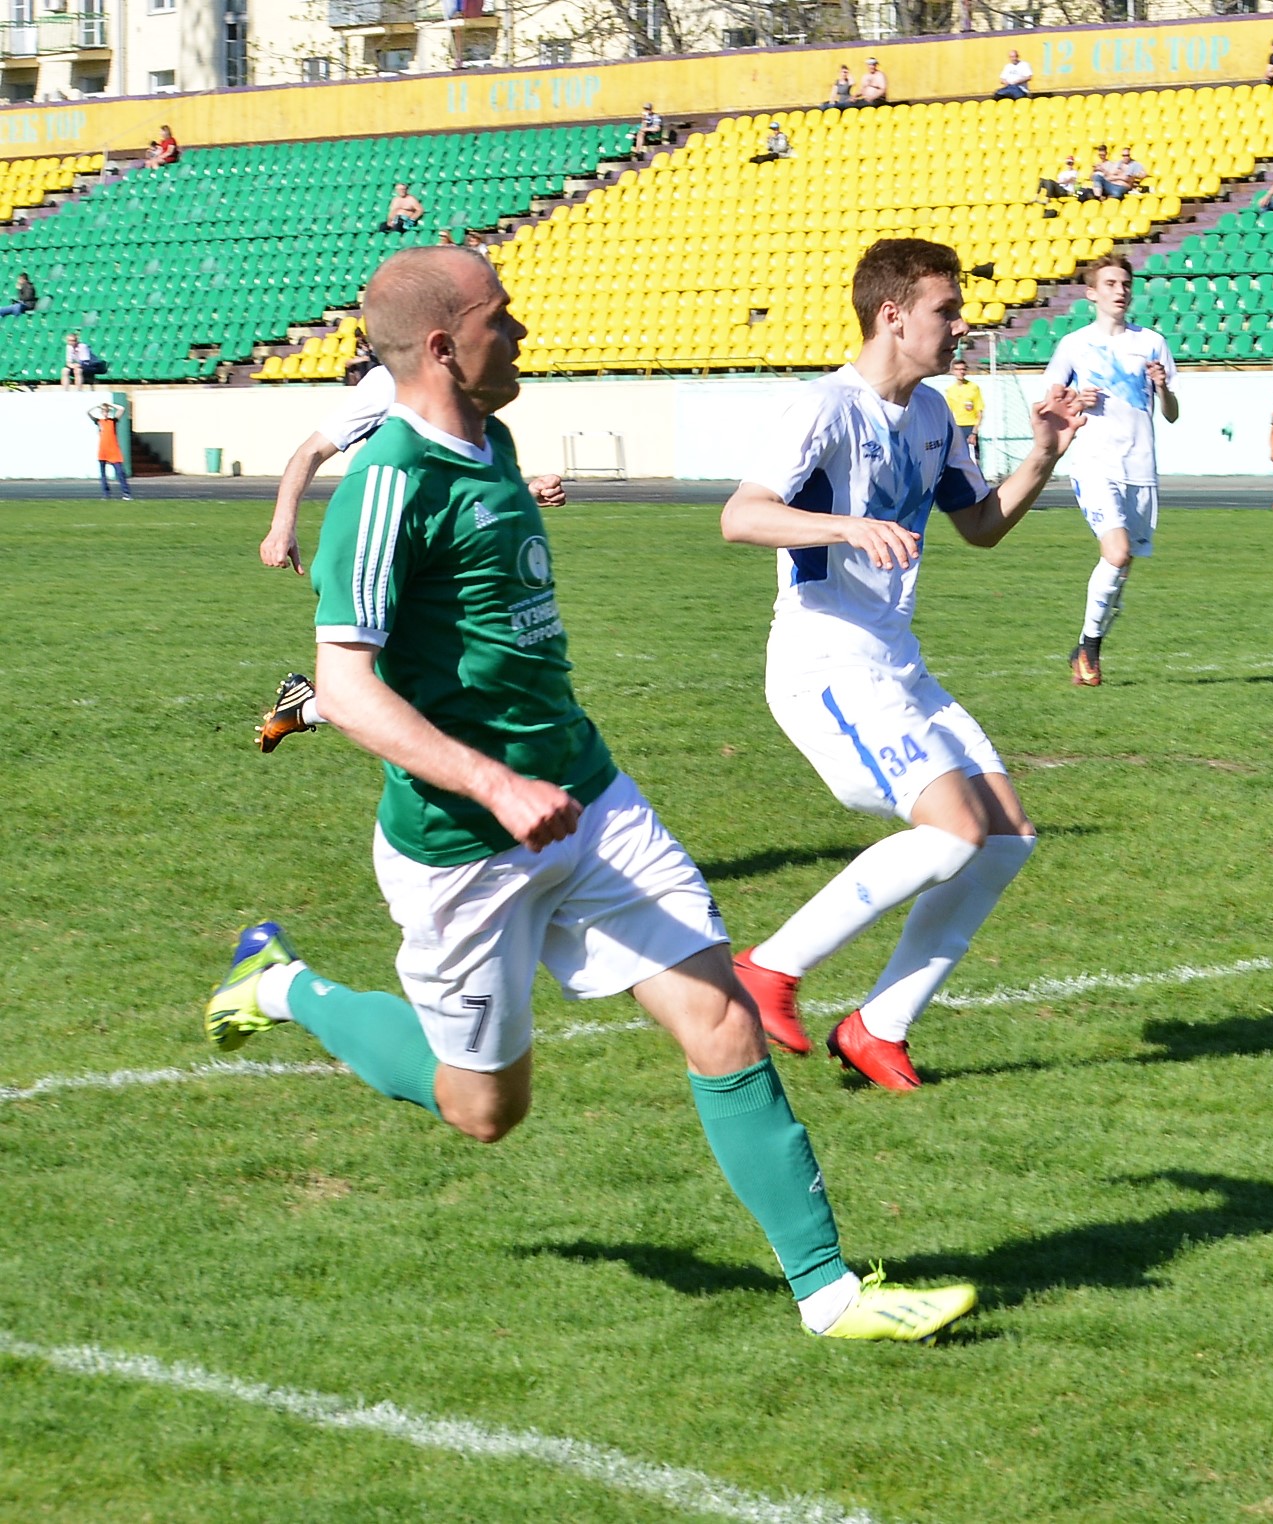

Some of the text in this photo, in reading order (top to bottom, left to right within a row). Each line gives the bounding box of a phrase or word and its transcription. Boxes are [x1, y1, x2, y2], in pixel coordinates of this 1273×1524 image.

[1042, 40, 1073, 75] 12
[880, 734, 928, 777] 34
[461, 994, 492, 1053] 7
